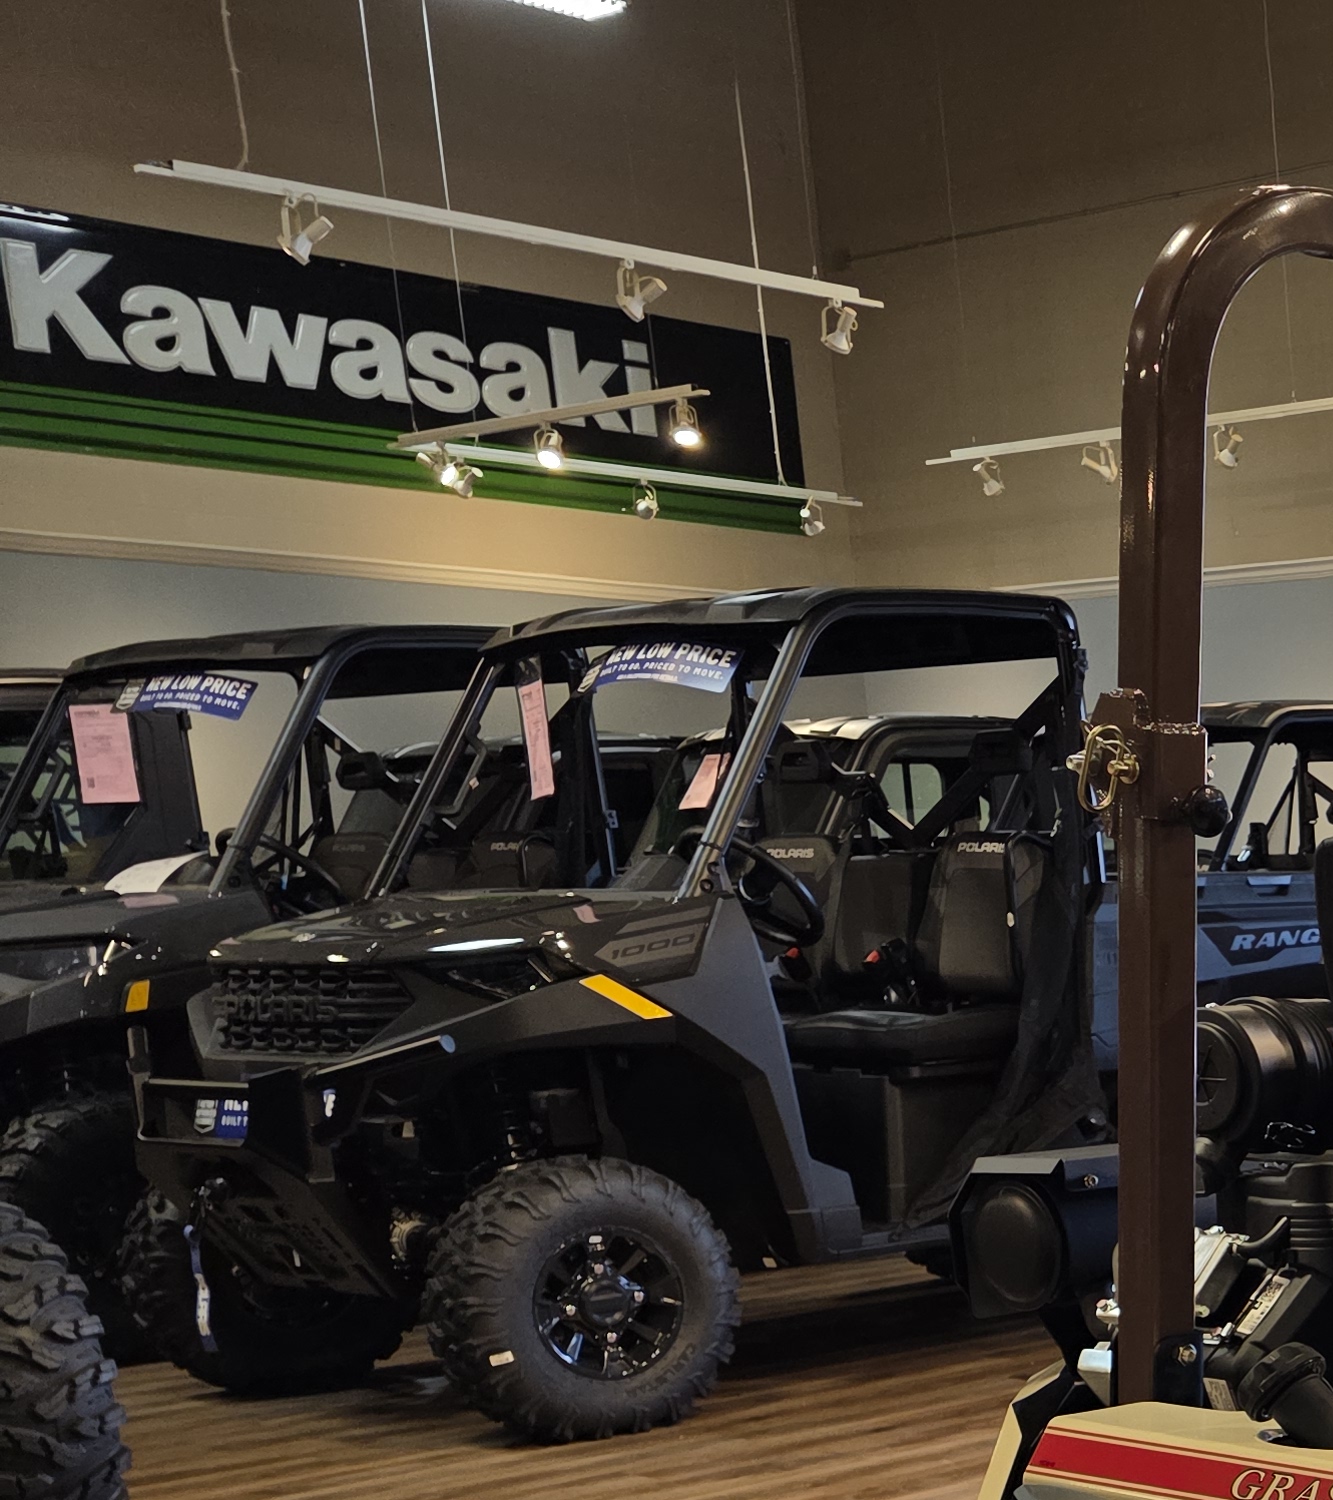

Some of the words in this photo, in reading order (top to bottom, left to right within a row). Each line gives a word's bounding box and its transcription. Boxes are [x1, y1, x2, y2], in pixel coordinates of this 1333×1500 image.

[1, 238, 660, 438] Kawasaki
[637, 643, 675, 660] LOW
[673, 643, 737, 668] PRICE
[146, 676, 174, 693] NEW
[171, 675, 202, 690] LOW
[200, 676, 252, 700] PRICE
[611, 933, 694, 959] 1000
[1230, 928, 1320, 951] RANG
